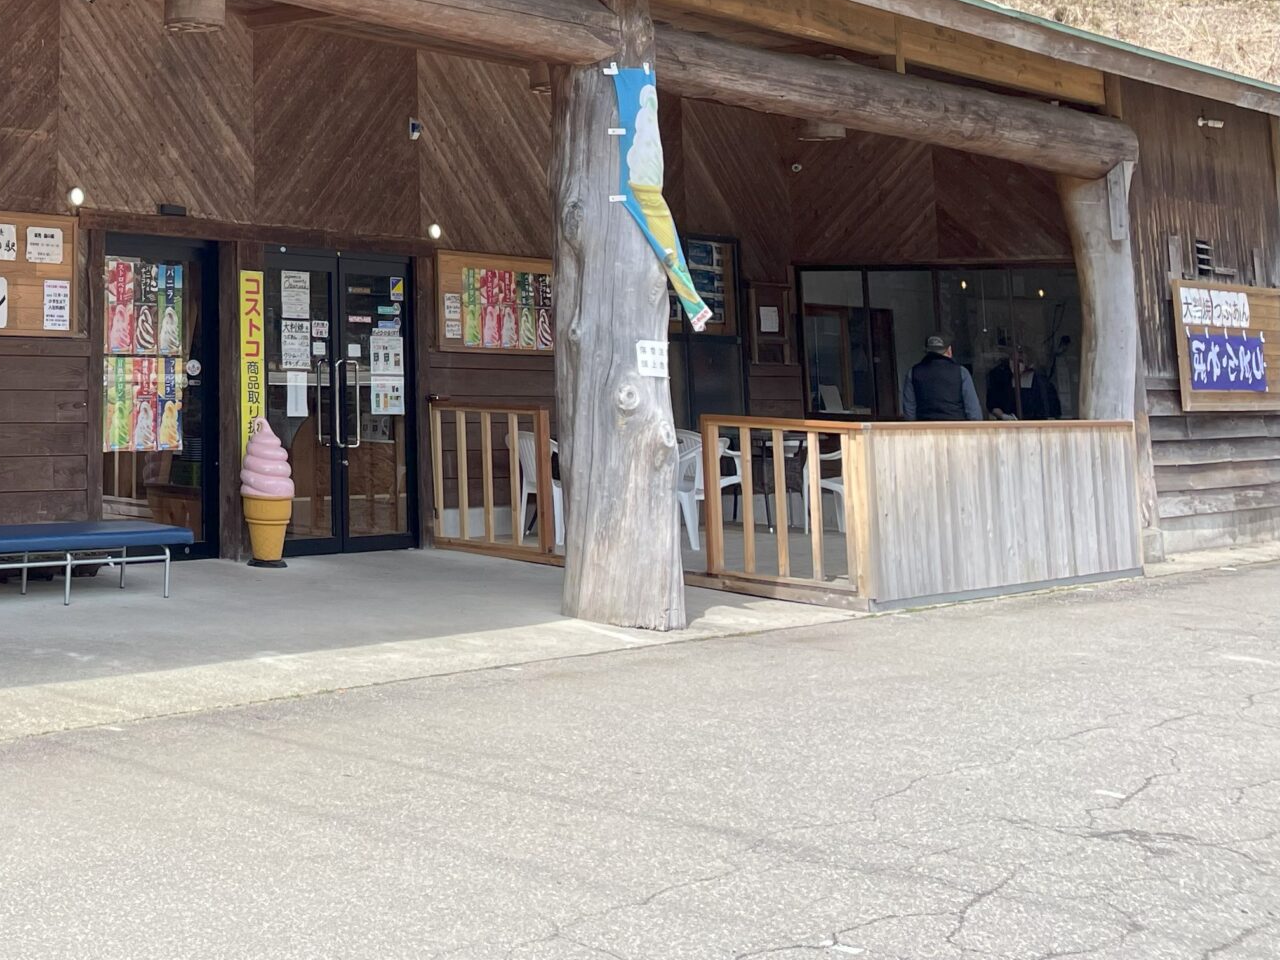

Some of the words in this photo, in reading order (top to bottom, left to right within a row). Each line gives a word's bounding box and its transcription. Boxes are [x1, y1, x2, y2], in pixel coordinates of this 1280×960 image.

[167, 269, 175, 299] バニラ
[244, 277, 262, 358] コストコ
[1214, 300, 1250, 322] つぶあん
